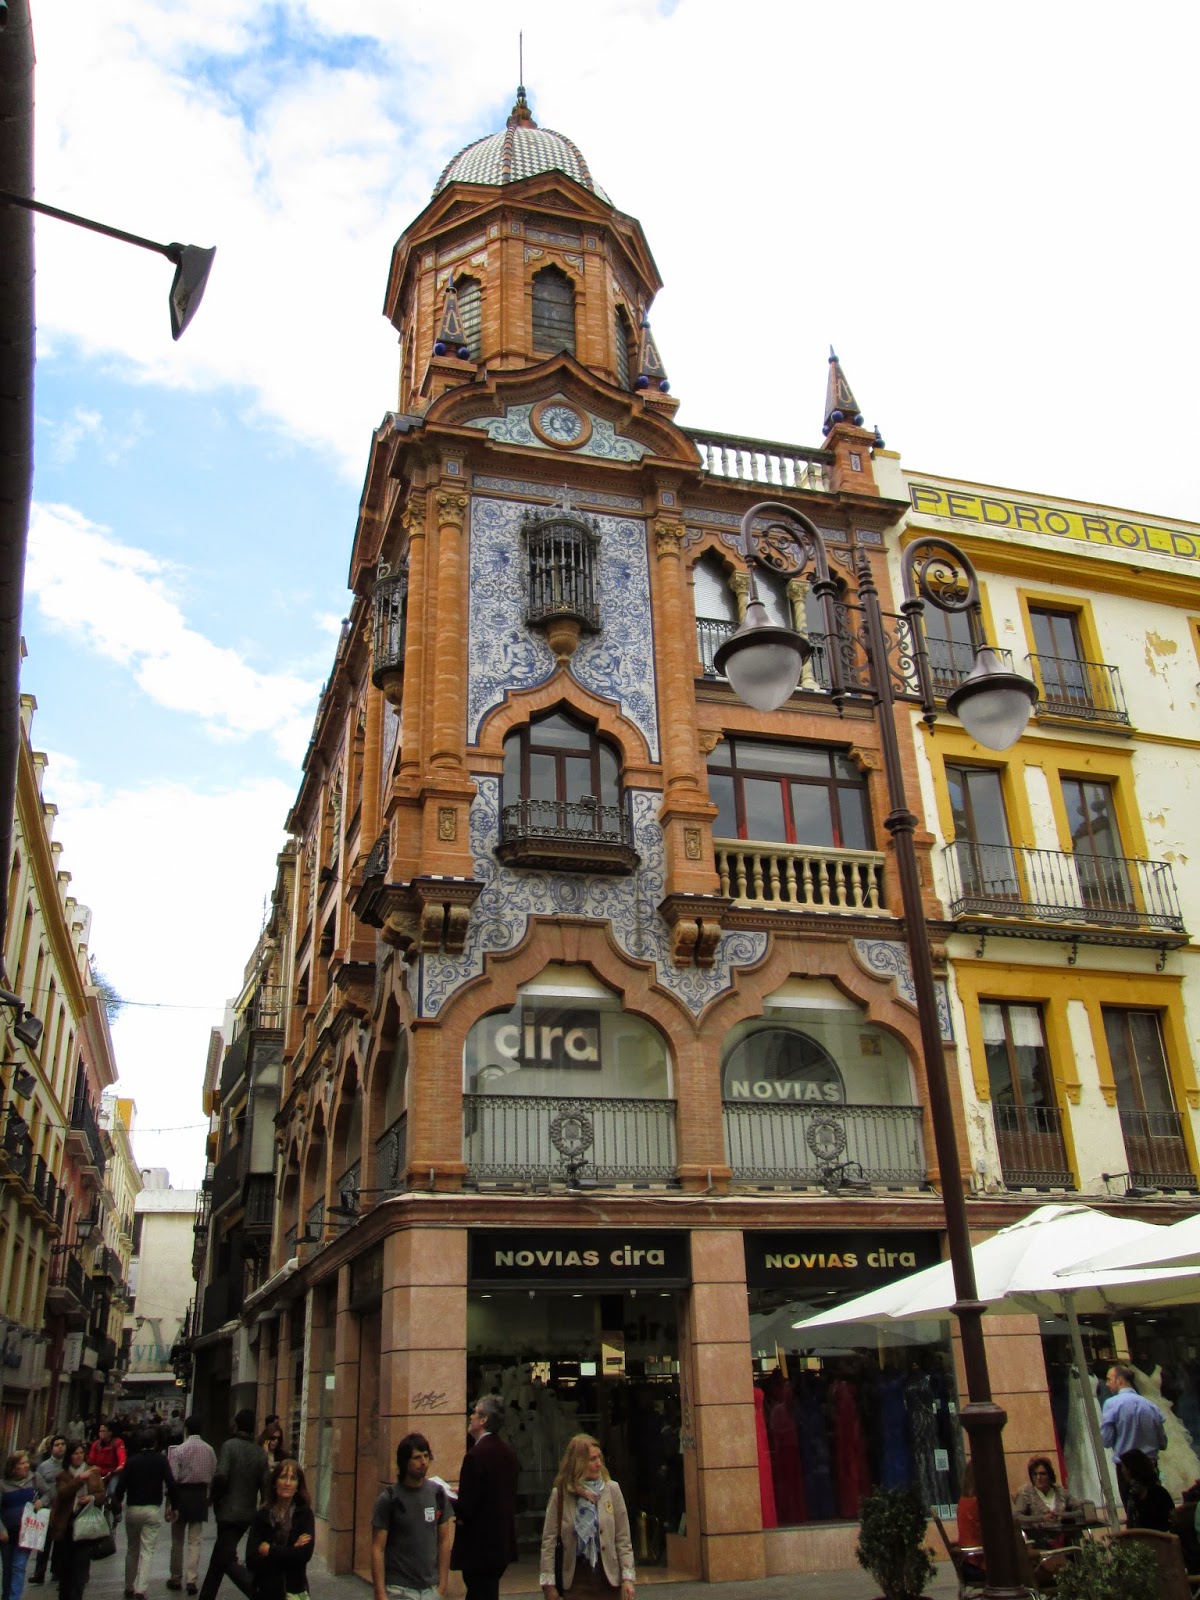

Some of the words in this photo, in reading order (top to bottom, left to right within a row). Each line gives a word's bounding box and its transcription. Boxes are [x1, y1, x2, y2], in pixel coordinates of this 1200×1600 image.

[911, 486, 1070, 535] PEDRO
[1082, 517, 1200, 558] ROLD
[495, 1011, 598, 1062] cira
[731, 1080, 840, 1101] NOVIAS
[495, 1250, 600, 1267] NOVIAS
[610, 1245, 665, 1266] cira
[765, 1253, 858, 1268] NOVIAS
[867, 1248, 916, 1268] cira
